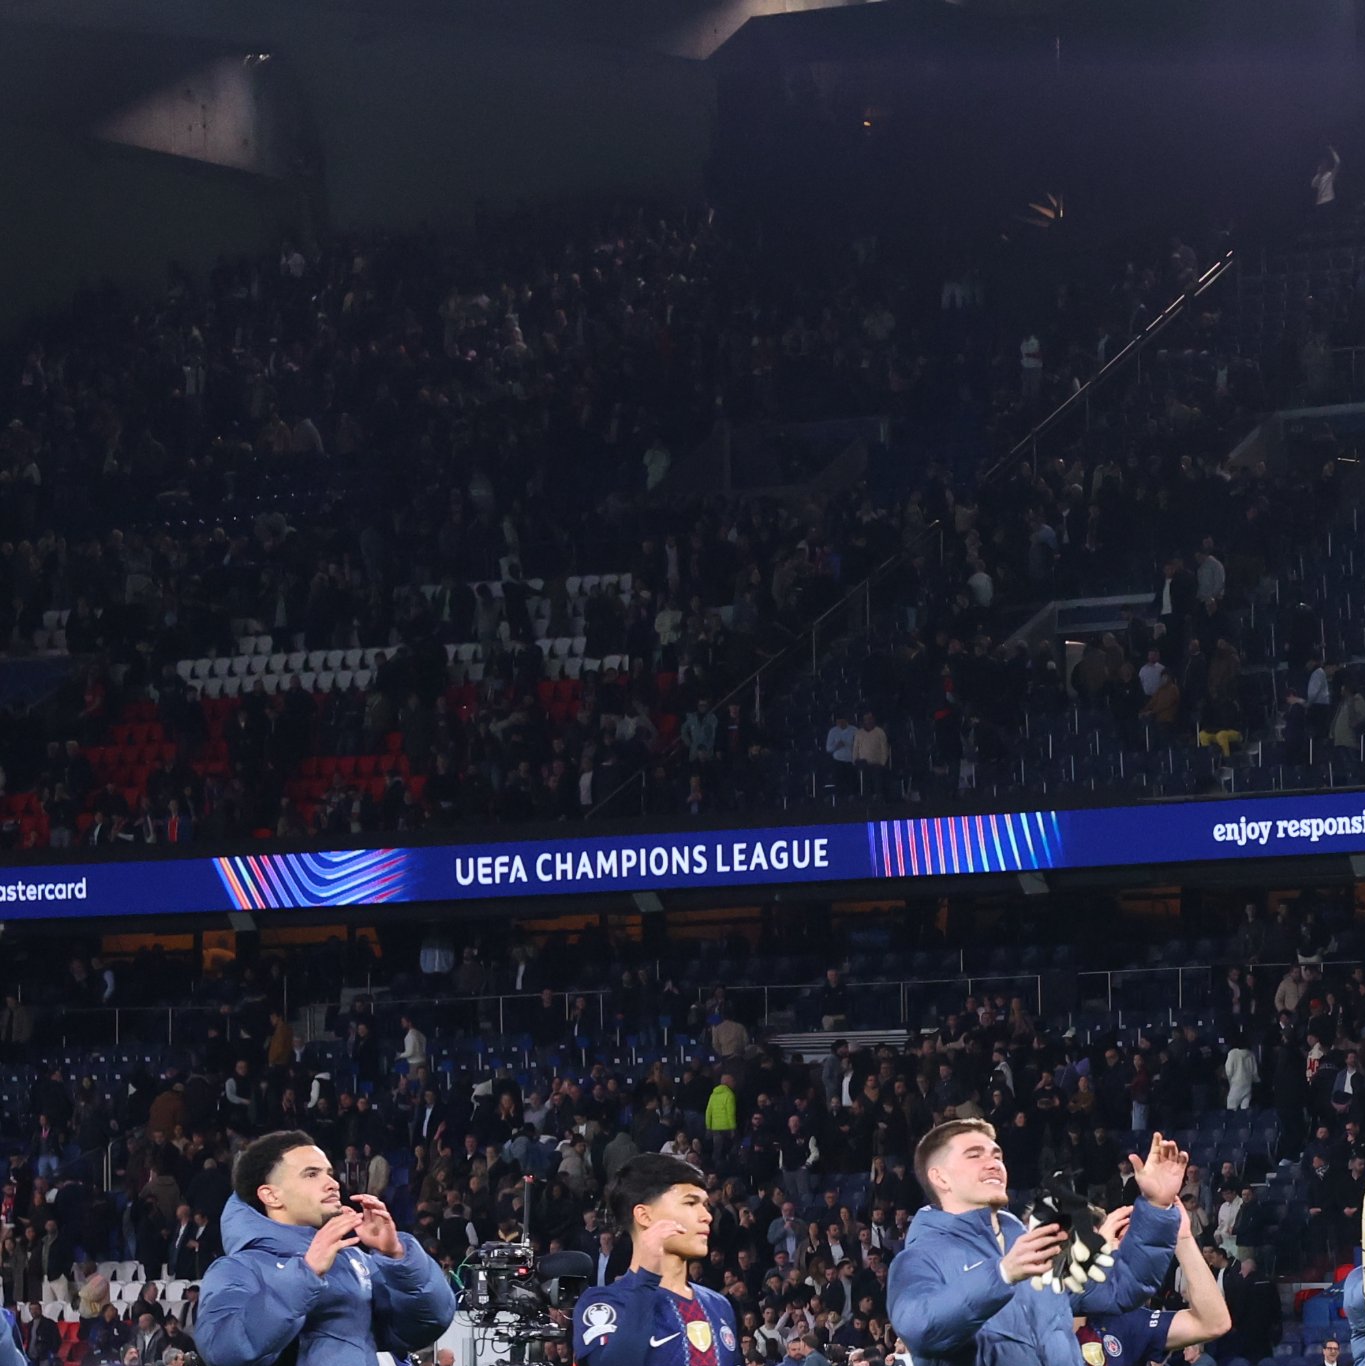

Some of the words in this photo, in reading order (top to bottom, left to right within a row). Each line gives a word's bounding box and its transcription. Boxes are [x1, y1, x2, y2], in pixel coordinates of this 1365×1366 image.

[1212, 815, 1273, 846] enjoy
[455, 854, 528, 886] UEFA
[535, 844, 708, 882] CHAMPIONS
[716, 838, 829, 873] LEAGUE
